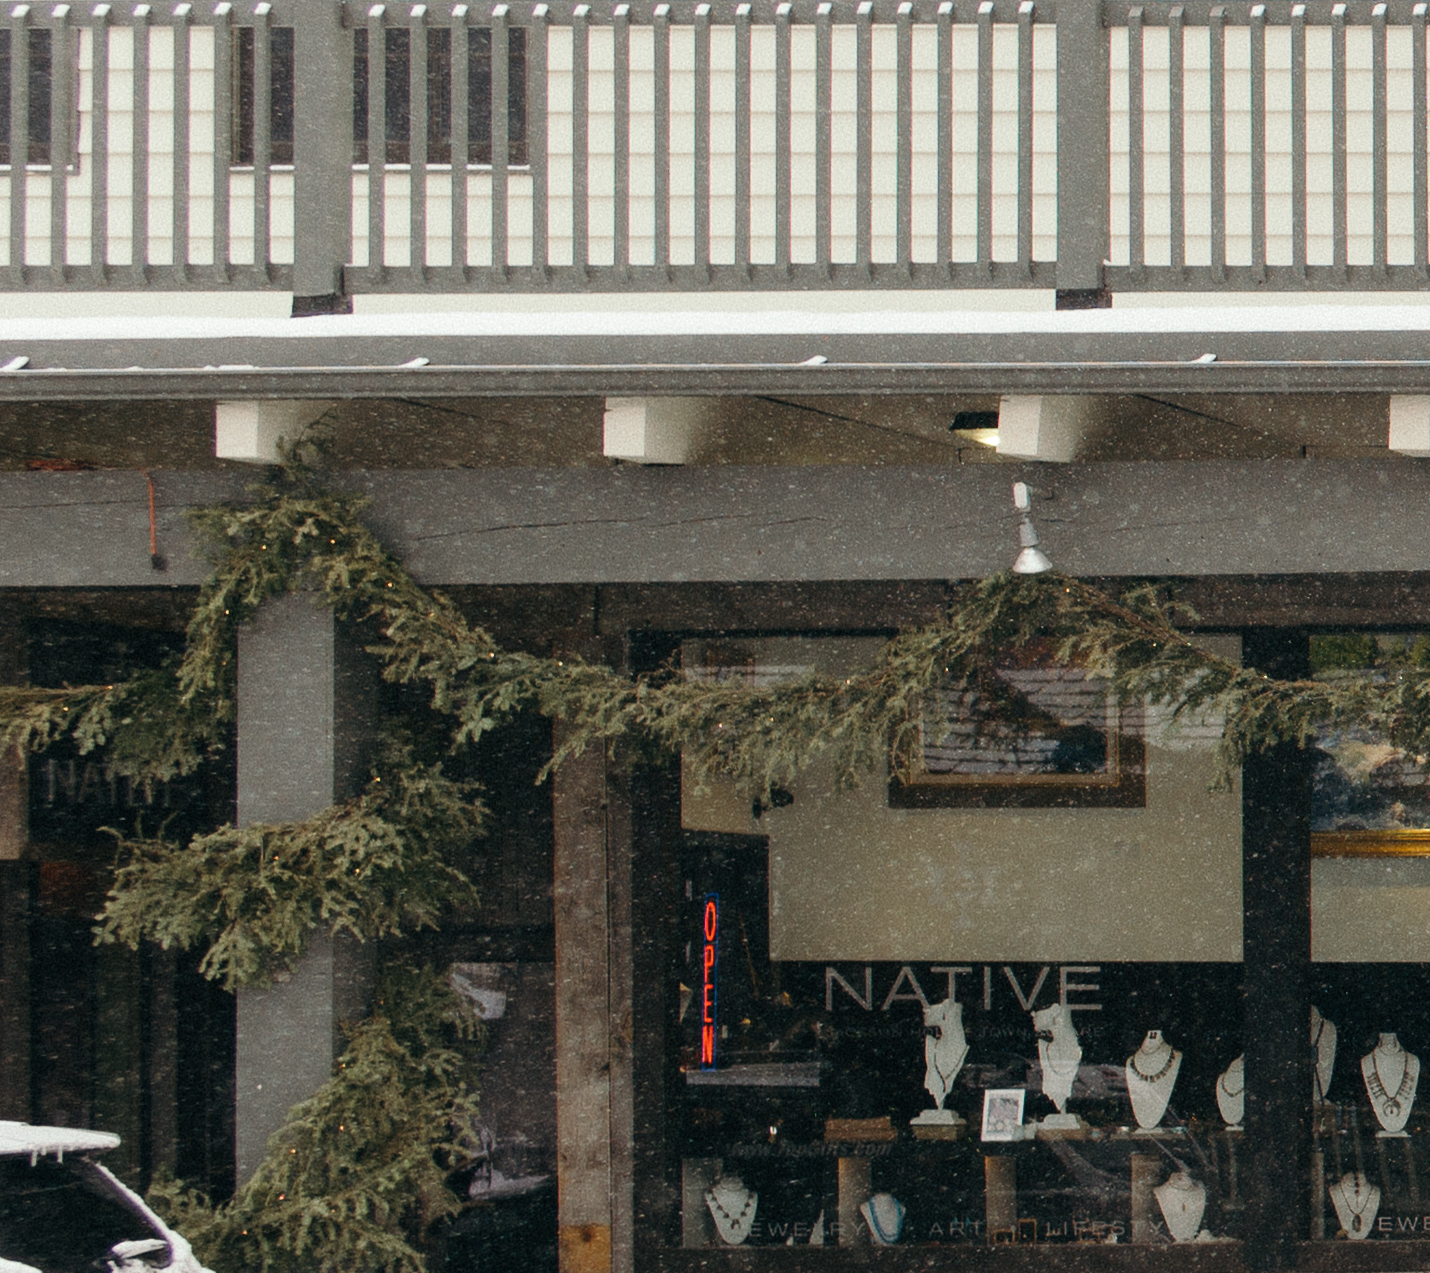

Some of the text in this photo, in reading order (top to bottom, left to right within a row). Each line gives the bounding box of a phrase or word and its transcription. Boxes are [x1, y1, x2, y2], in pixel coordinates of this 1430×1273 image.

[703, 901, 716, 1065] OPEN
[825, 966, 1103, 1011] NATIVE
[929, 1220, 985, 1237] ART
